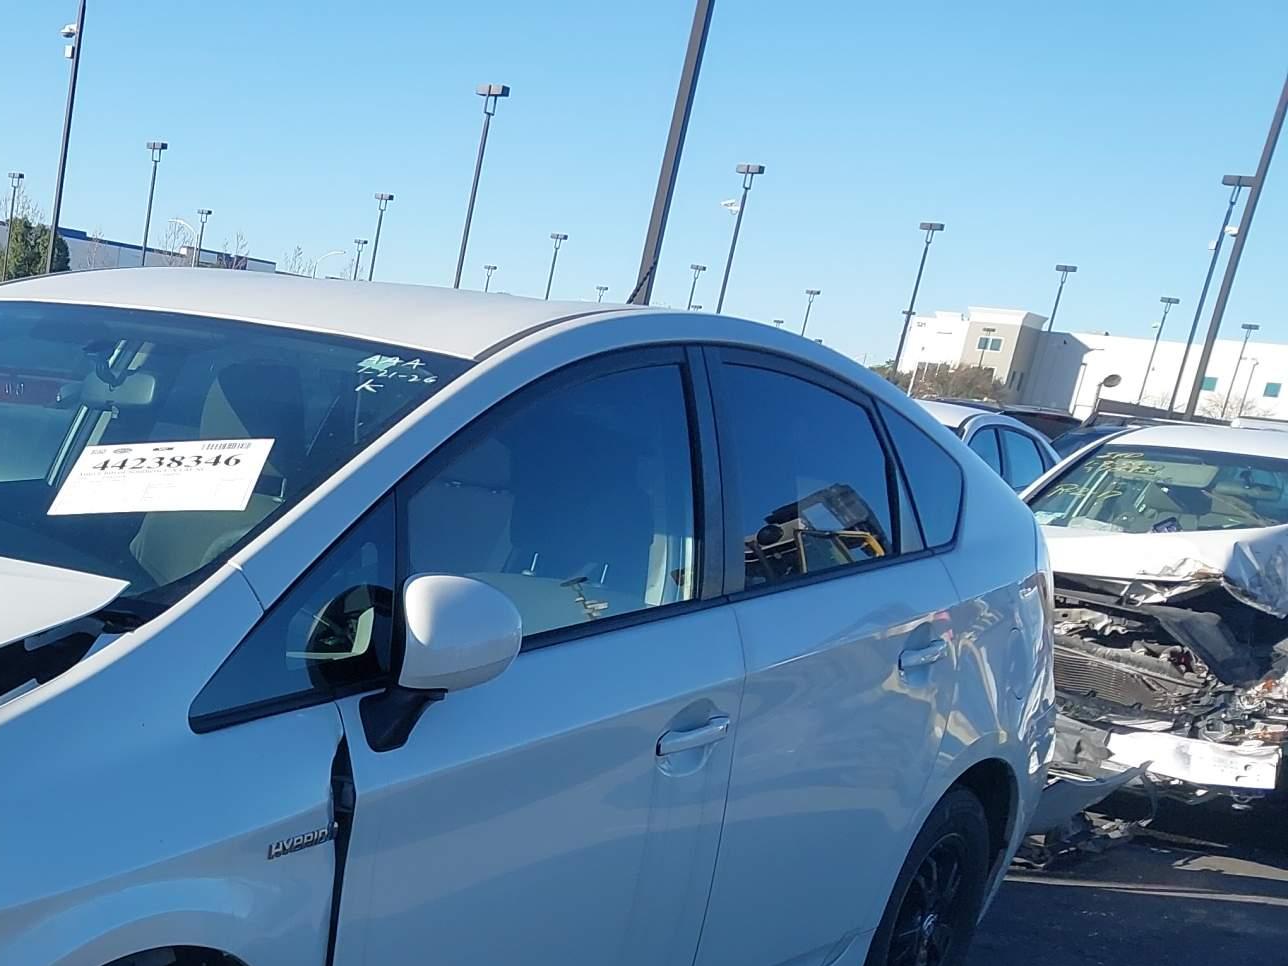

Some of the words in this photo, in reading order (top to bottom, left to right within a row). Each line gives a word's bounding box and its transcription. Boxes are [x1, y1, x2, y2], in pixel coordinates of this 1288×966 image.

[355, 378, 384, 393] K
[92, 453, 247, 471] 44238346
[268, 829, 330, 860] HYBRID
